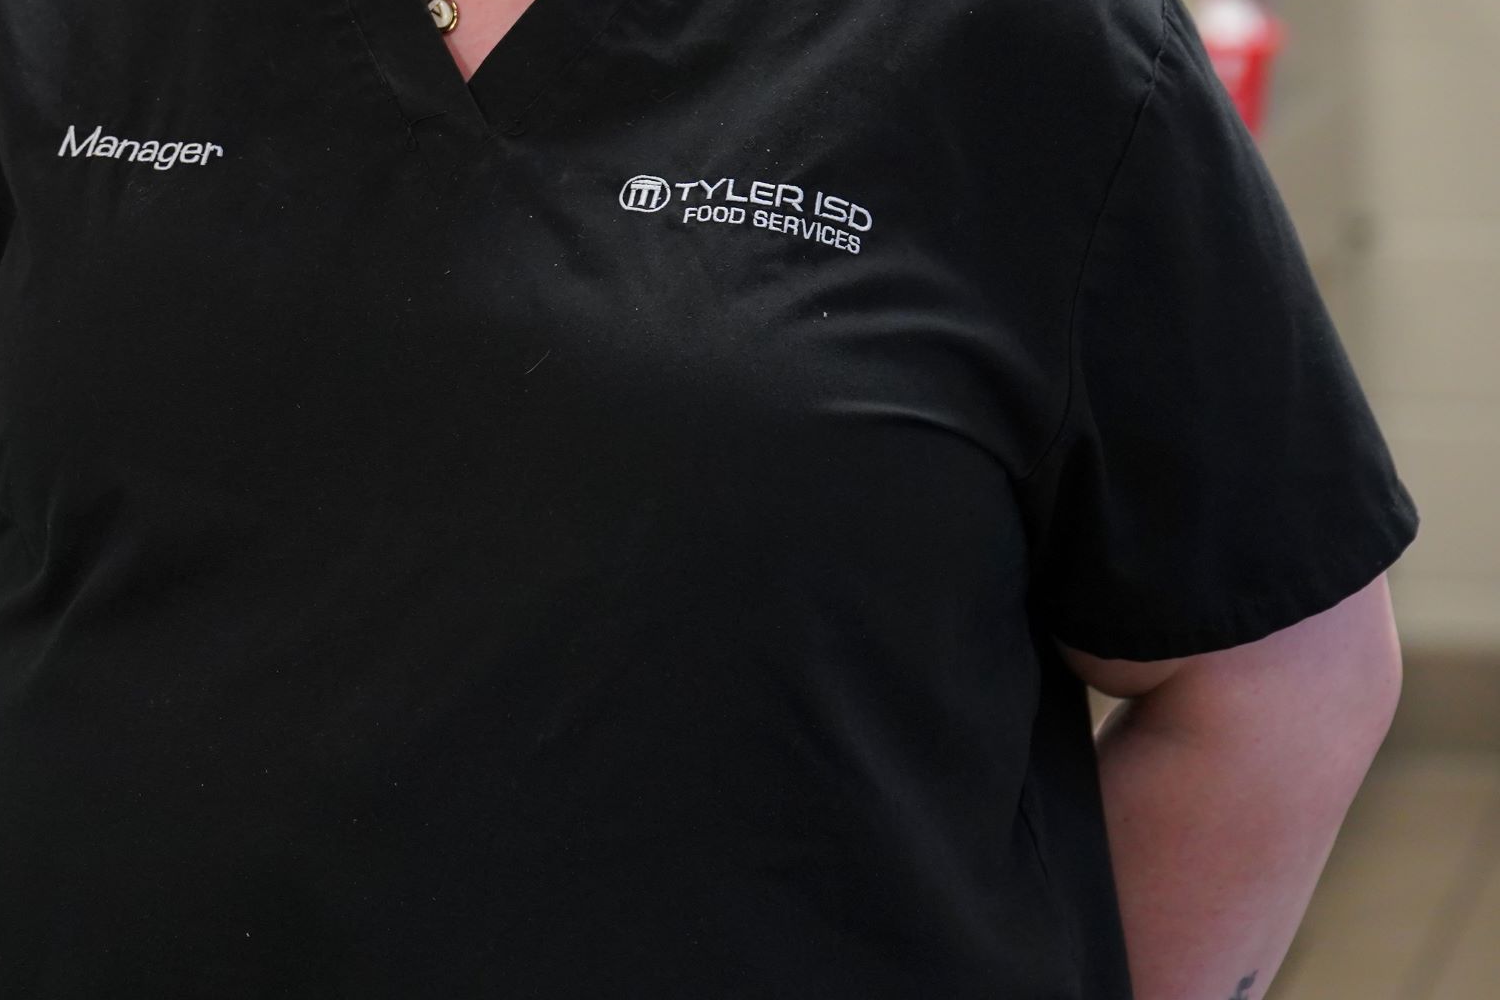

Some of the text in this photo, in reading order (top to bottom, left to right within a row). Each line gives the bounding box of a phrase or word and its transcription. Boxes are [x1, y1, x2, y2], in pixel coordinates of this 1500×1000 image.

[57, 125, 224, 171] Manager
[675, 177, 873, 232] TYLER ISD
[682, 205, 861, 255] FOOD SERVICES
